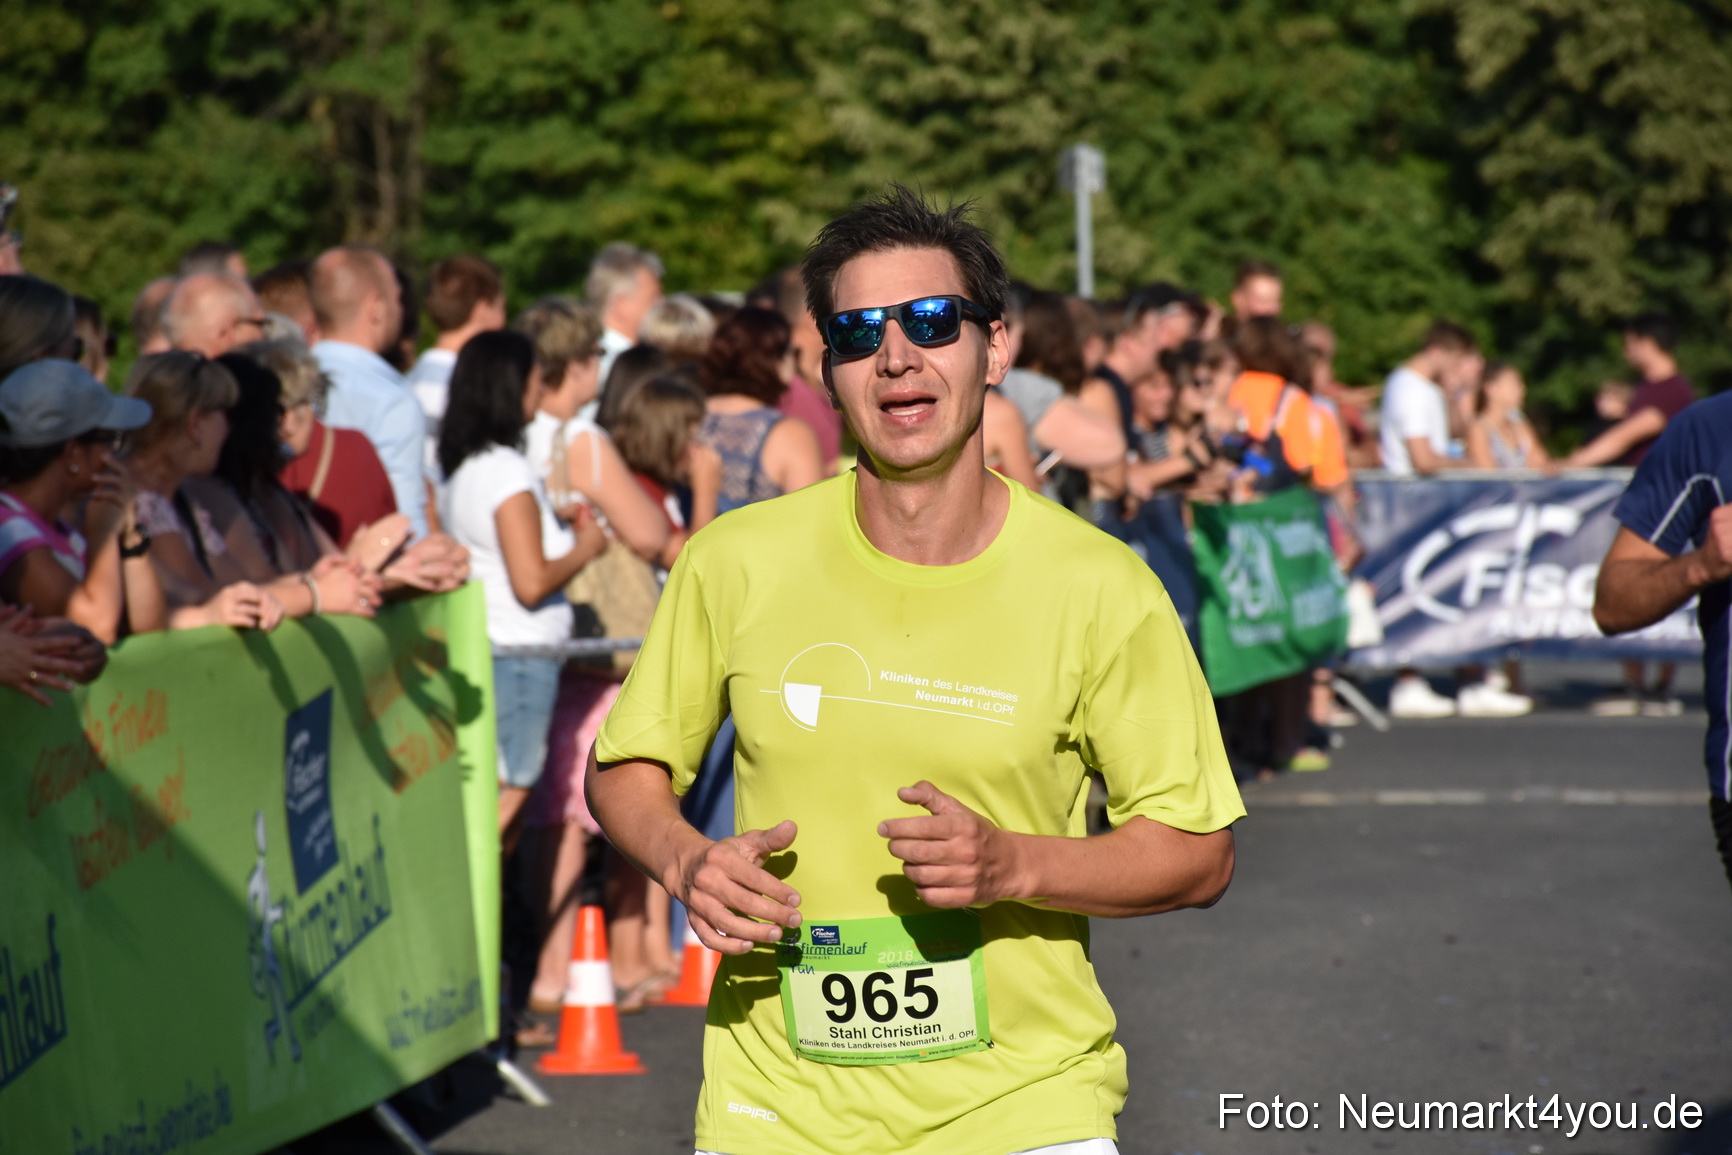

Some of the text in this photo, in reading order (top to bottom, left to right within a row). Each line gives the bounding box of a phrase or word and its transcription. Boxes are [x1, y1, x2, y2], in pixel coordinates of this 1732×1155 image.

[880, 670, 1018, 702] Kliniken des Landkreises
[915, 690, 974, 707] Neumarkt
[801, 942, 868, 955] firmenlauf
[878, 951, 913, 963] 2018
[821, 967, 939, 1024] 965
[829, 1022, 942, 1039] Stahl Christian
[799, 1038, 830, 1048] Kliniken
[831, 1040, 846, 1049] des
[847, 1040, 897, 1049] Landkreises
[899, 1036, 940, 1048] Neumarkt
[727, 1102, 778, 1122] SPIRO
